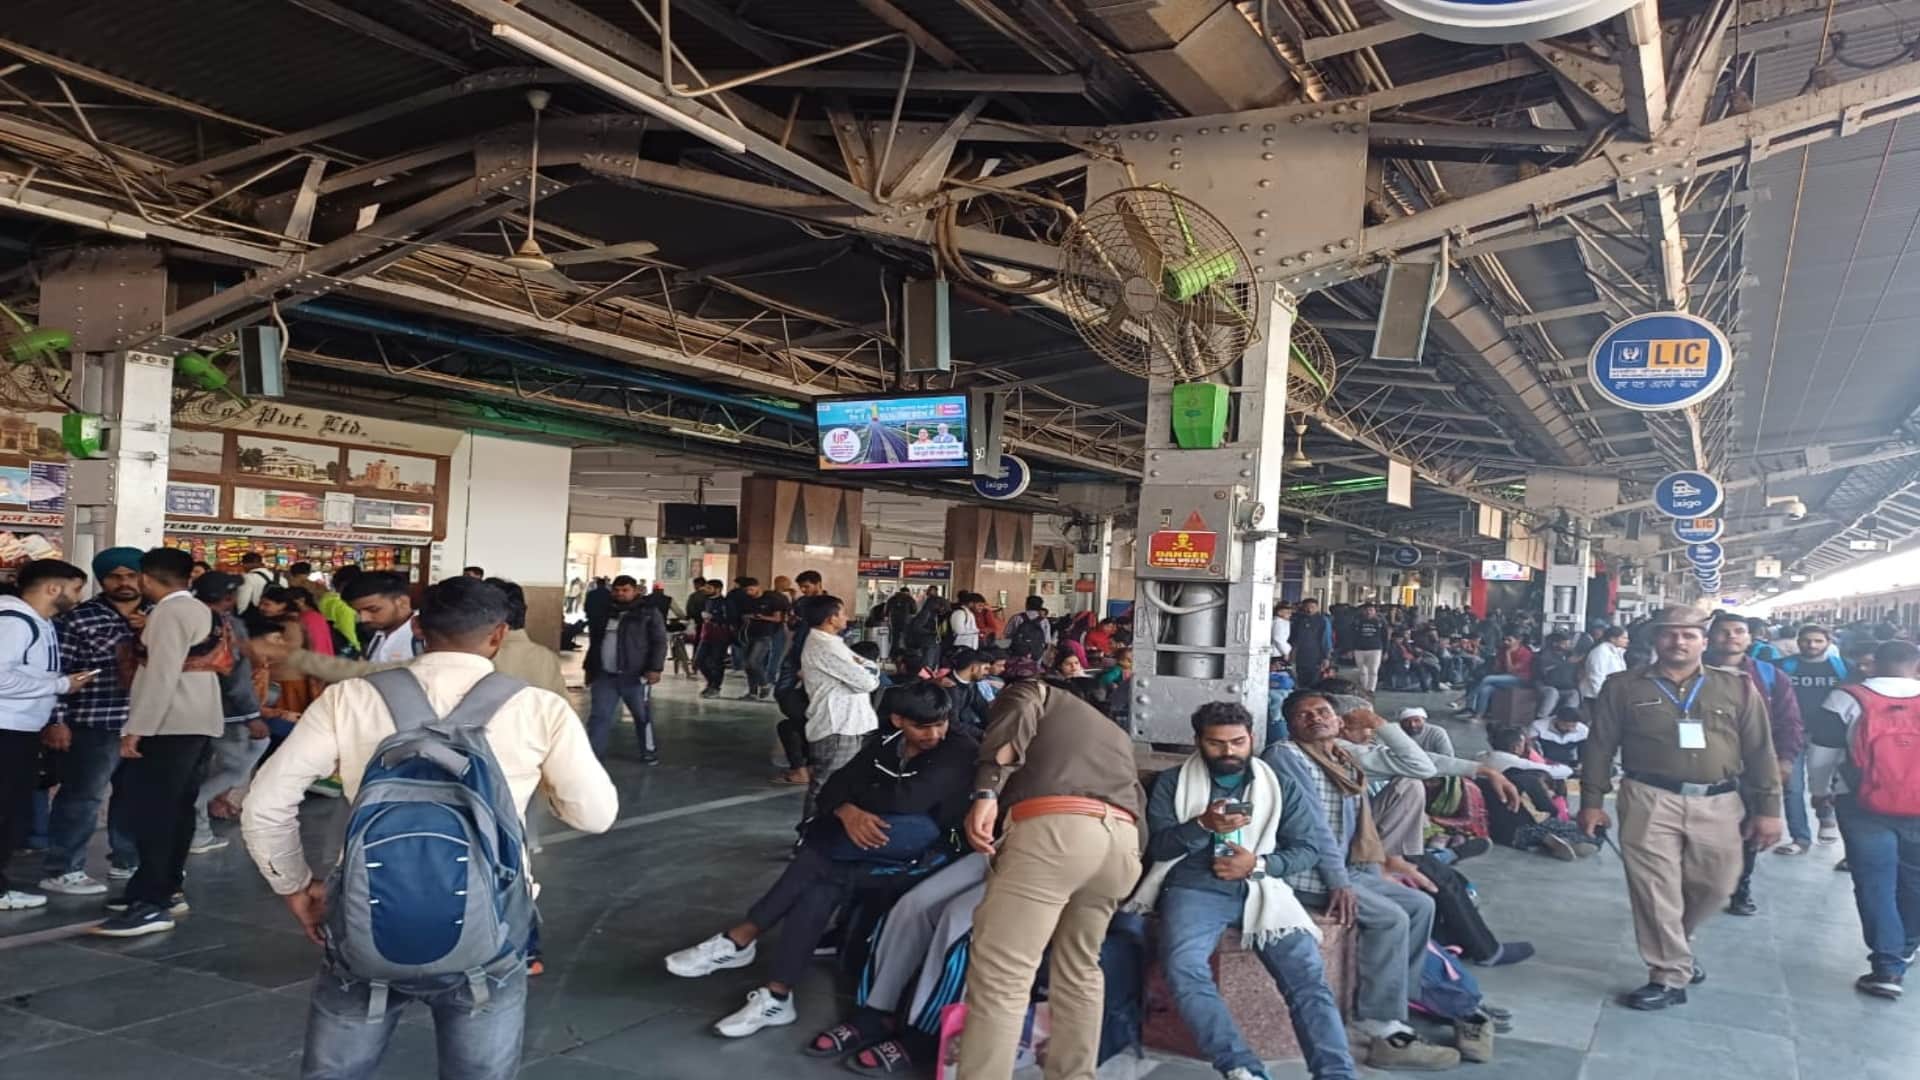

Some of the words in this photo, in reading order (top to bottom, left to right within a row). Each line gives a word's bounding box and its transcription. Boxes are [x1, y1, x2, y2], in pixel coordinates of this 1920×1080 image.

[1655, 343, 1700, 365] LIC
[200, 398, 241, 419] Co.
[256, 404, 309, 428] Pvt.
[317, 414, 368, 437] Ltd.
[1673, 499, 1702, 509] ixigo
[1696, 519, 1713, 528] LIC
[224, 526, 252, 534] MRP
[264, 528, 297, 537] MULTI
[299, 530, 344, 539] PURPOSE
